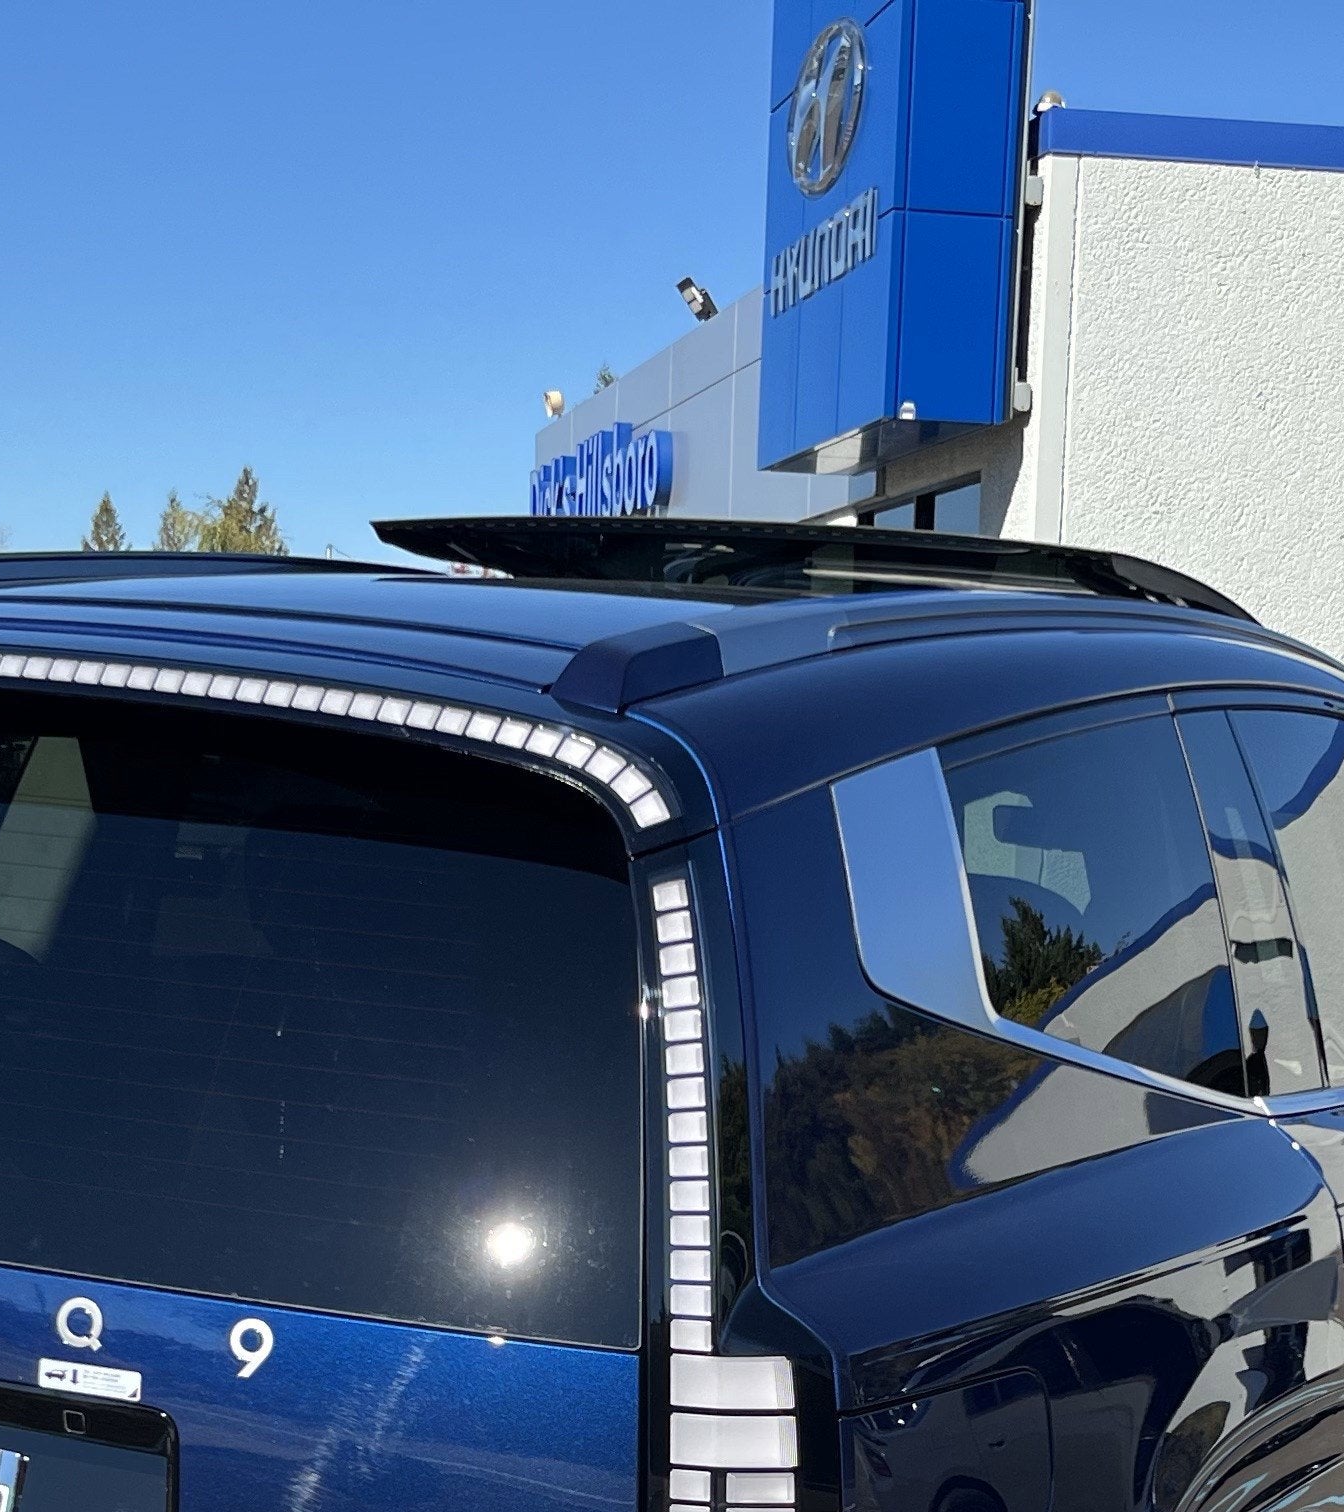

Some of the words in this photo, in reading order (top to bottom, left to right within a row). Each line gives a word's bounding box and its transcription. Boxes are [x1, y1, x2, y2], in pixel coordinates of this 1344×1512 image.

[770, 186, 878, 317] HYUNDAI
[575, 422, 662, 517] Hillsboro
[229, 1317, 274, 1378] 9
